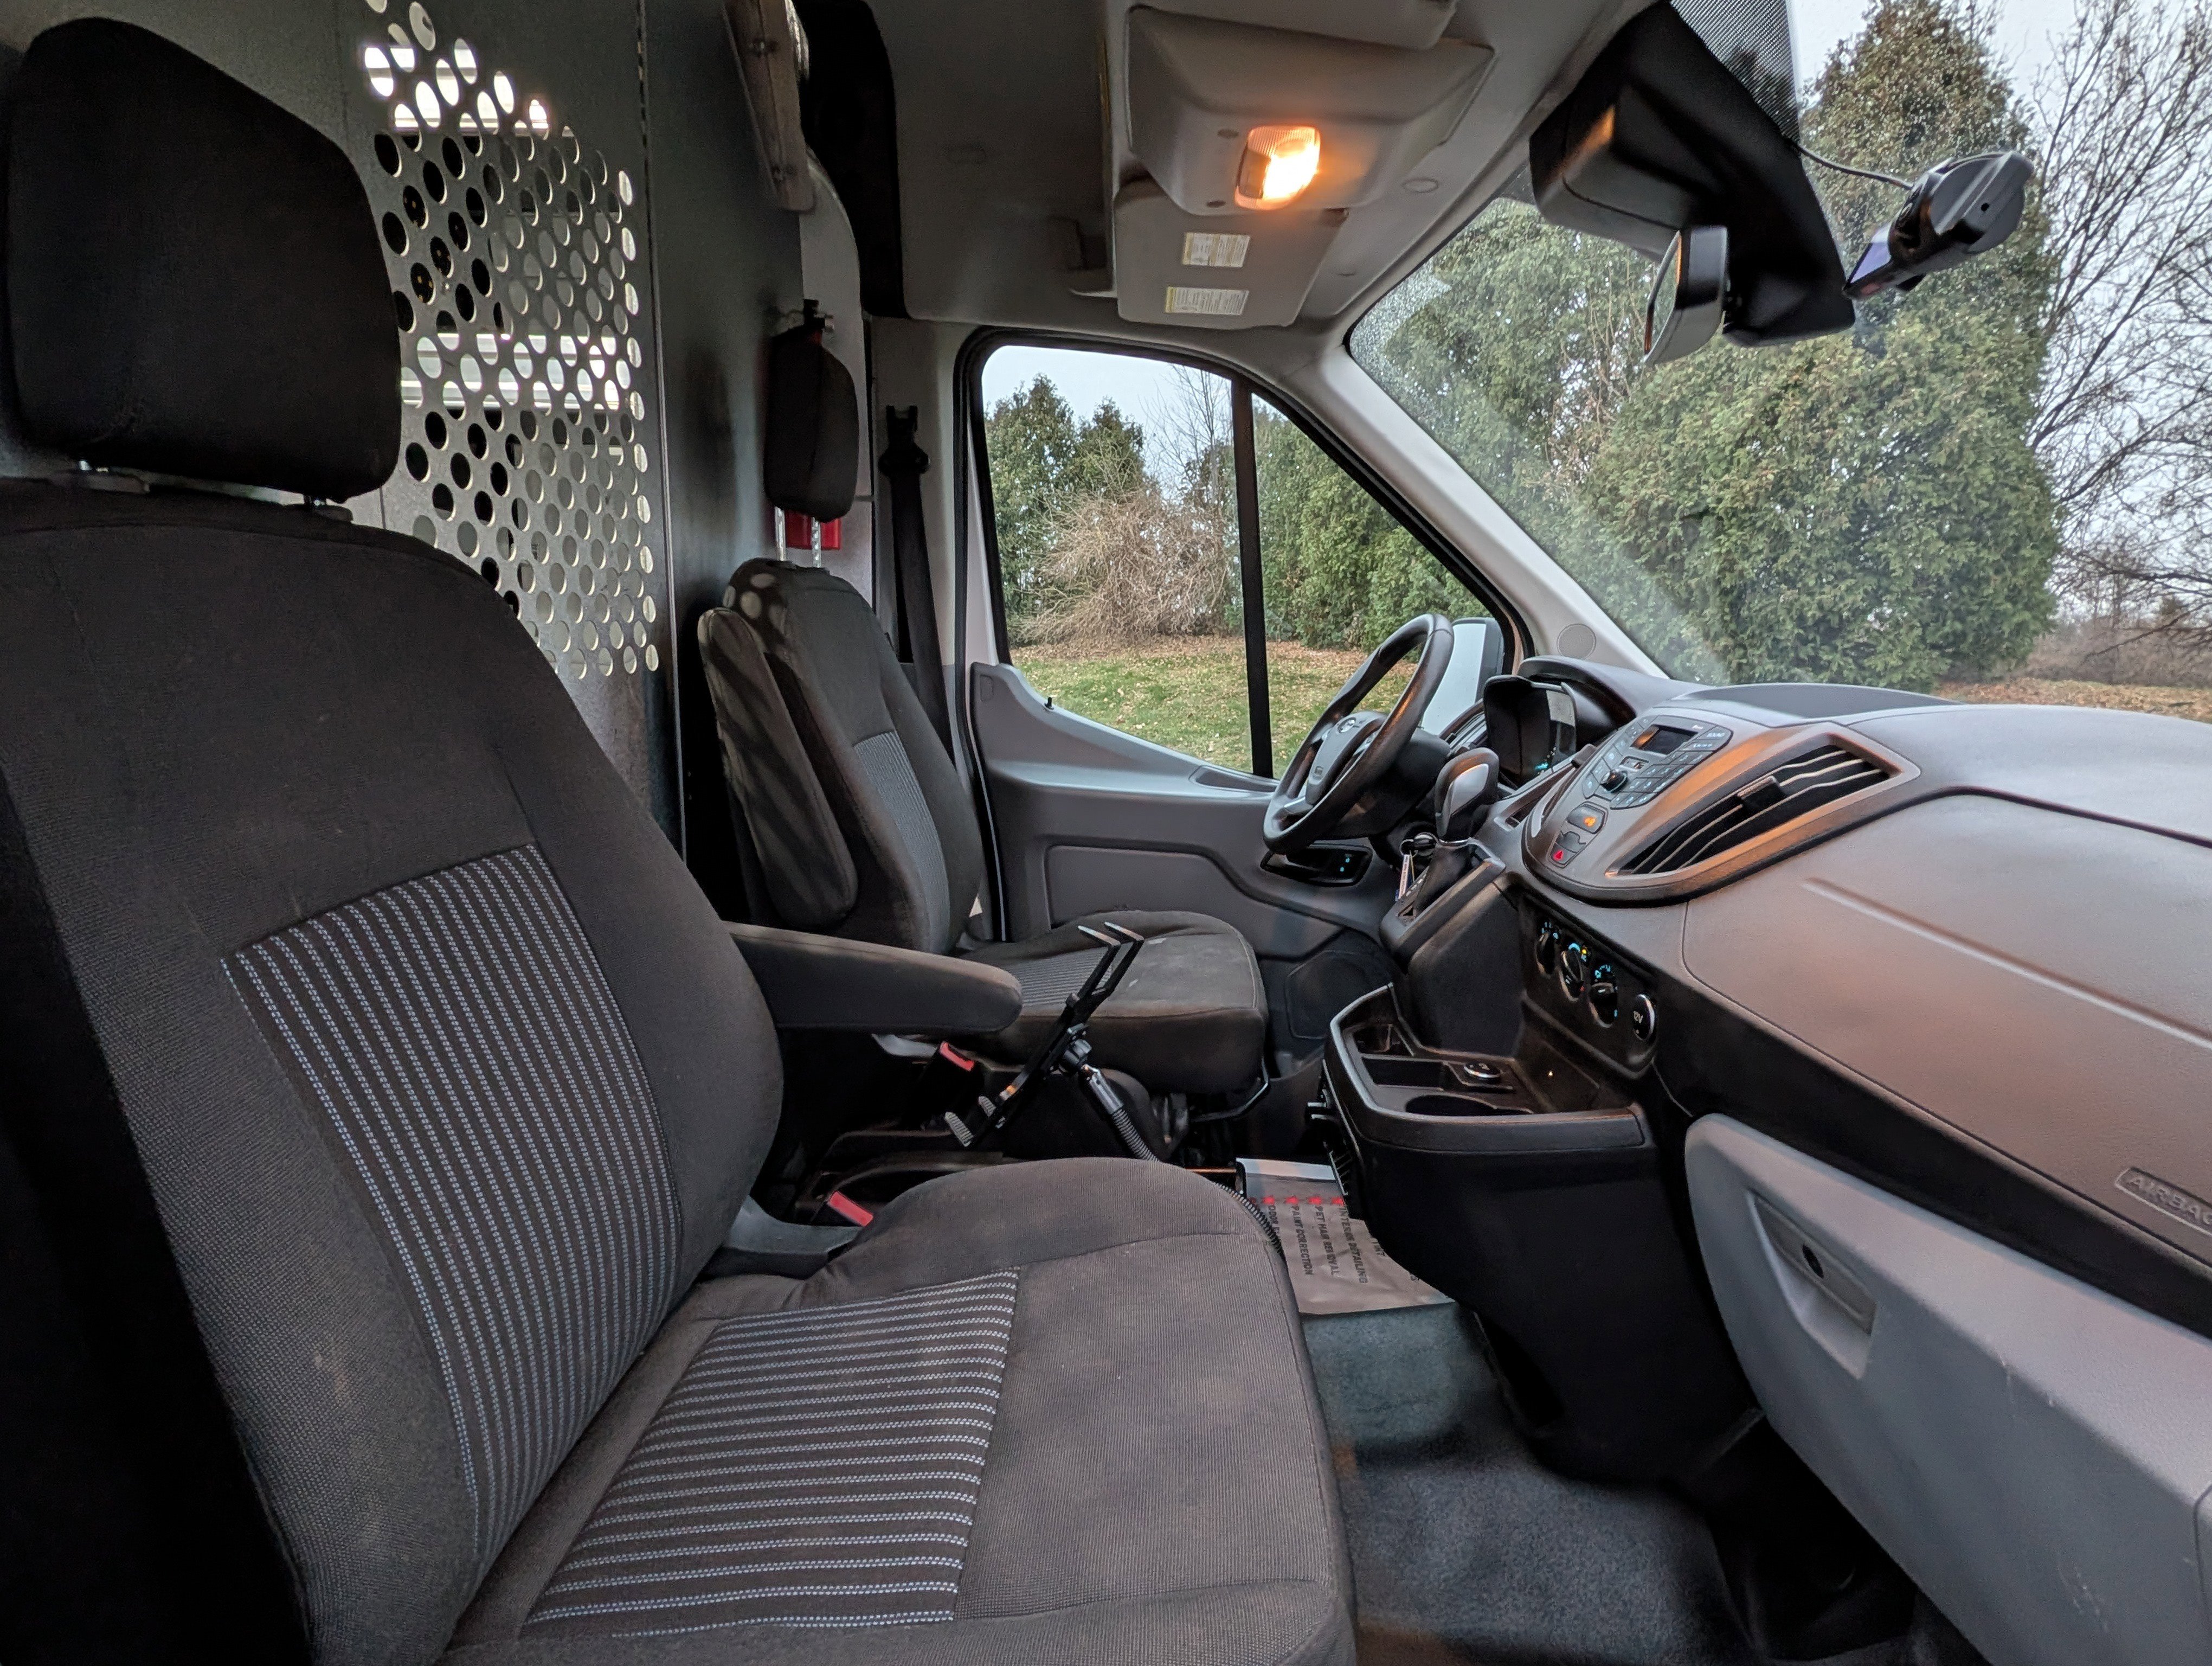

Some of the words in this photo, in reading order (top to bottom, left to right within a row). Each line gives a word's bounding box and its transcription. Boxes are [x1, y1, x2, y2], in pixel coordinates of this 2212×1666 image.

[1291, 1205, 1303, 1228] PAINT
[1315, 1205, 1326, 1222] PET
[1296, 1229, 1313, 1275] CORRECTION
[1348, 1242, 1368, 1283] DETAILING
